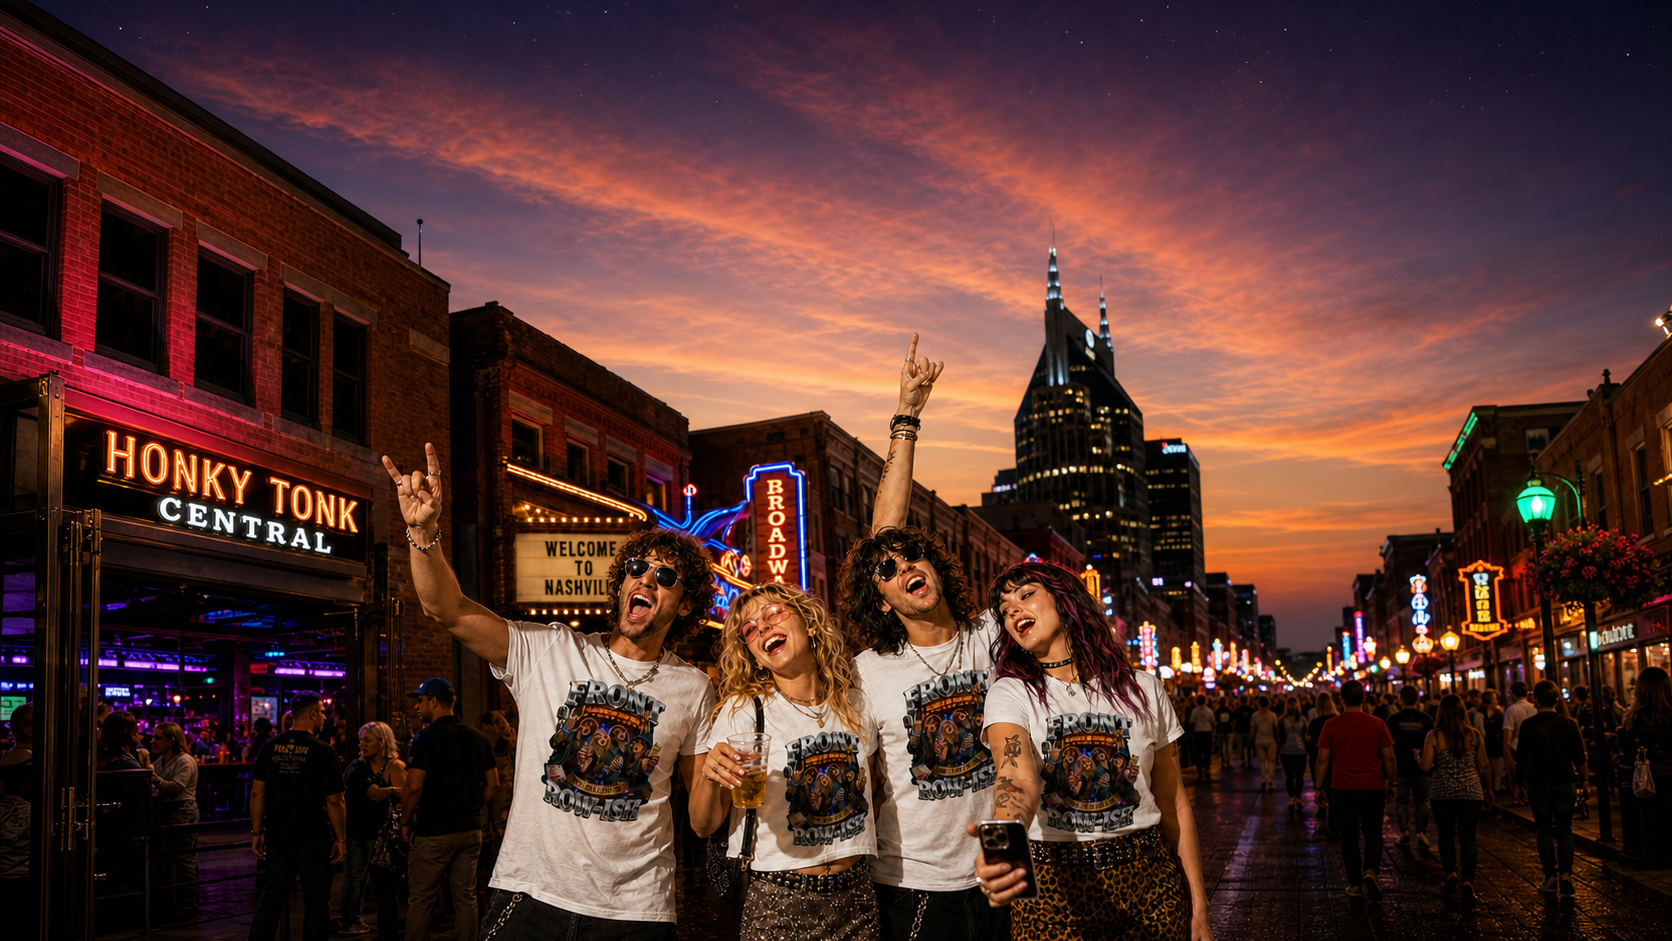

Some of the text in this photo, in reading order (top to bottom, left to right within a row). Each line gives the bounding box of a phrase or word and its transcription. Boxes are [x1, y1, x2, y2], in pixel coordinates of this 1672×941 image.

[106, 430, 358, 533] HONKY TONK
[158, 497, 332, 554] CENTRAL
[545, 541, 617, 557] WELCOME
[574, 560, 593, 576] TO
[565, 679, 666, 726] FRONT
[903, 670, 989, 711] FRONT
[1046, 711, 1133, 740] FRONT
[785, 731, 860, 761] FRONT
